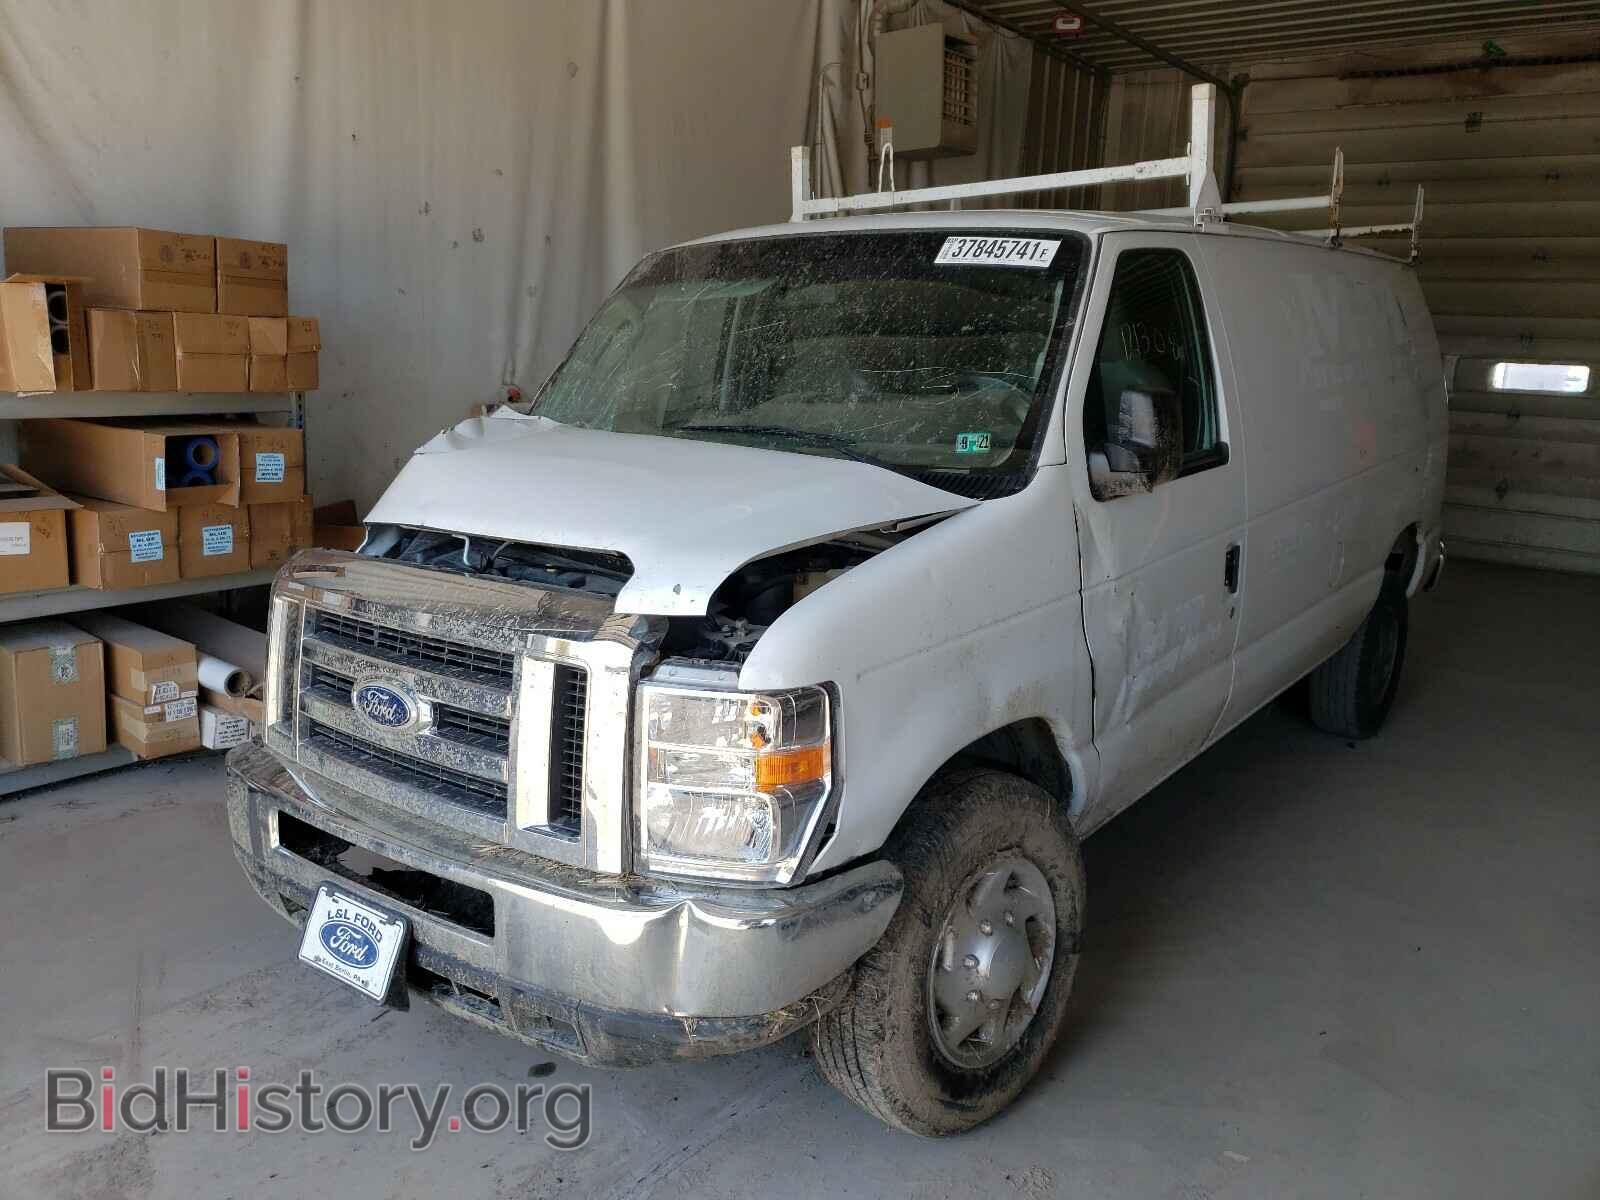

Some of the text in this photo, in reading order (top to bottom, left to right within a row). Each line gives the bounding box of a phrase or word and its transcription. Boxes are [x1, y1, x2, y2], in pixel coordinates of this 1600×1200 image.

[951, 238, 1041, 260] 37845741
[961, 436, 969, 449] 9
[364, 690, 397, 721] Ford
[327, 909, 382, 943] L&L FORD
[330, 926, 369, 960] Ford
